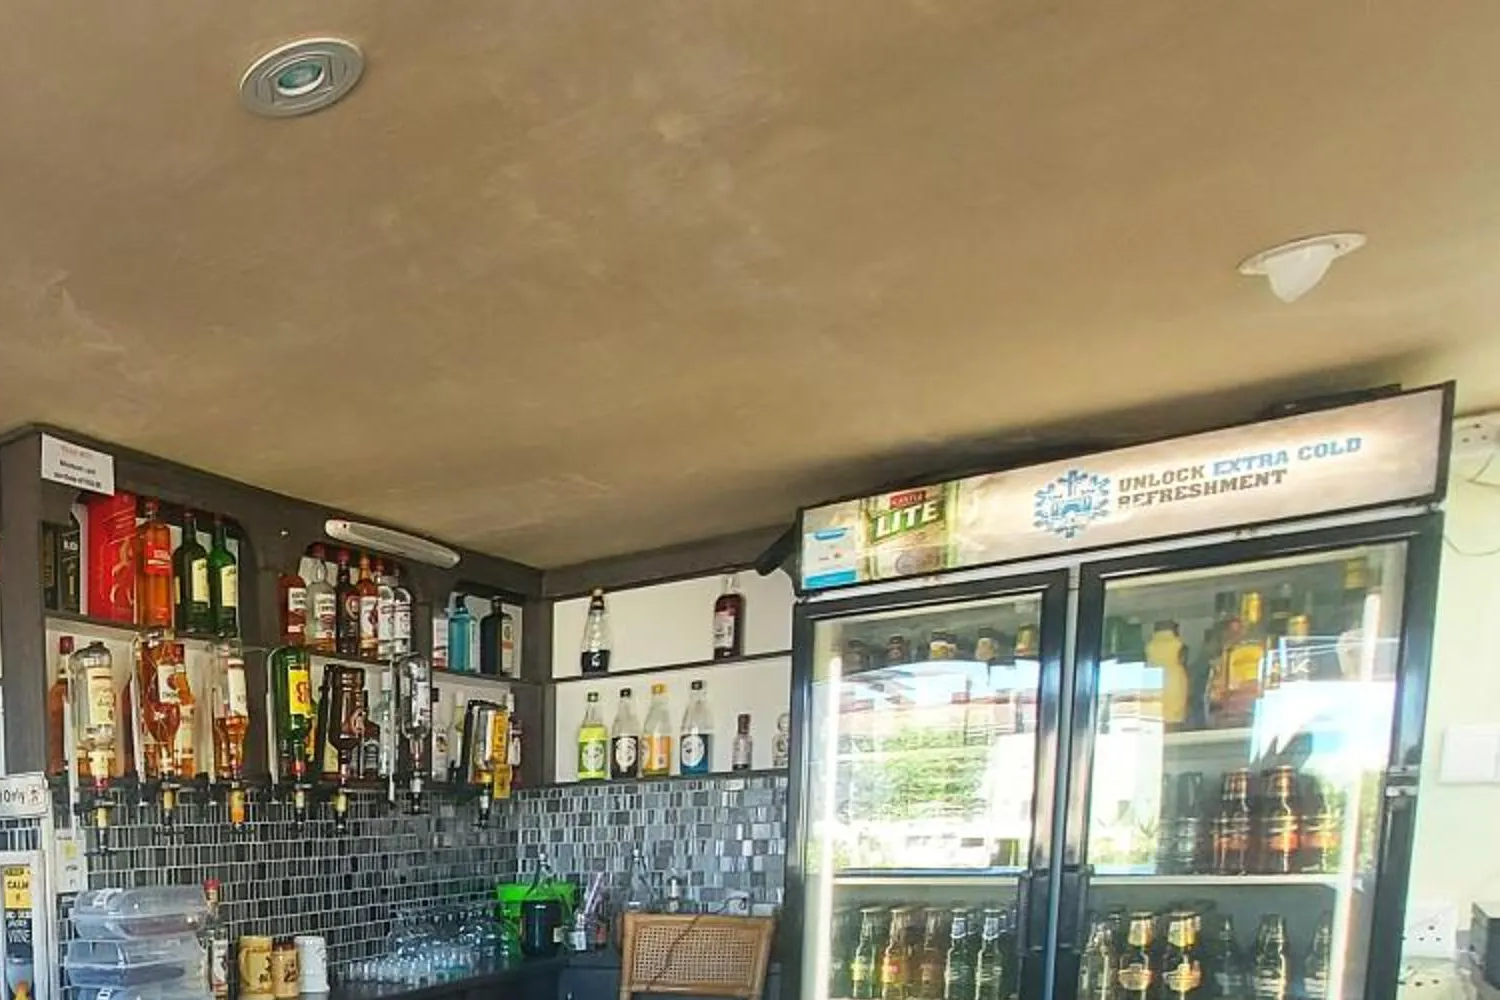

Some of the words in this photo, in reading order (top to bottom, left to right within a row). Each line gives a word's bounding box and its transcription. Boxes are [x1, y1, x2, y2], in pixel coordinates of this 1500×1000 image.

[1117, 464, 1206, 493] UNLOCK
[1211, 450, 1290, 477] EXTRA
[1297, 437, 1363, 462] COLD
[1117, 469, 1288, 509] REFRESHMENT
[875, 501, 940, 538] LITE
